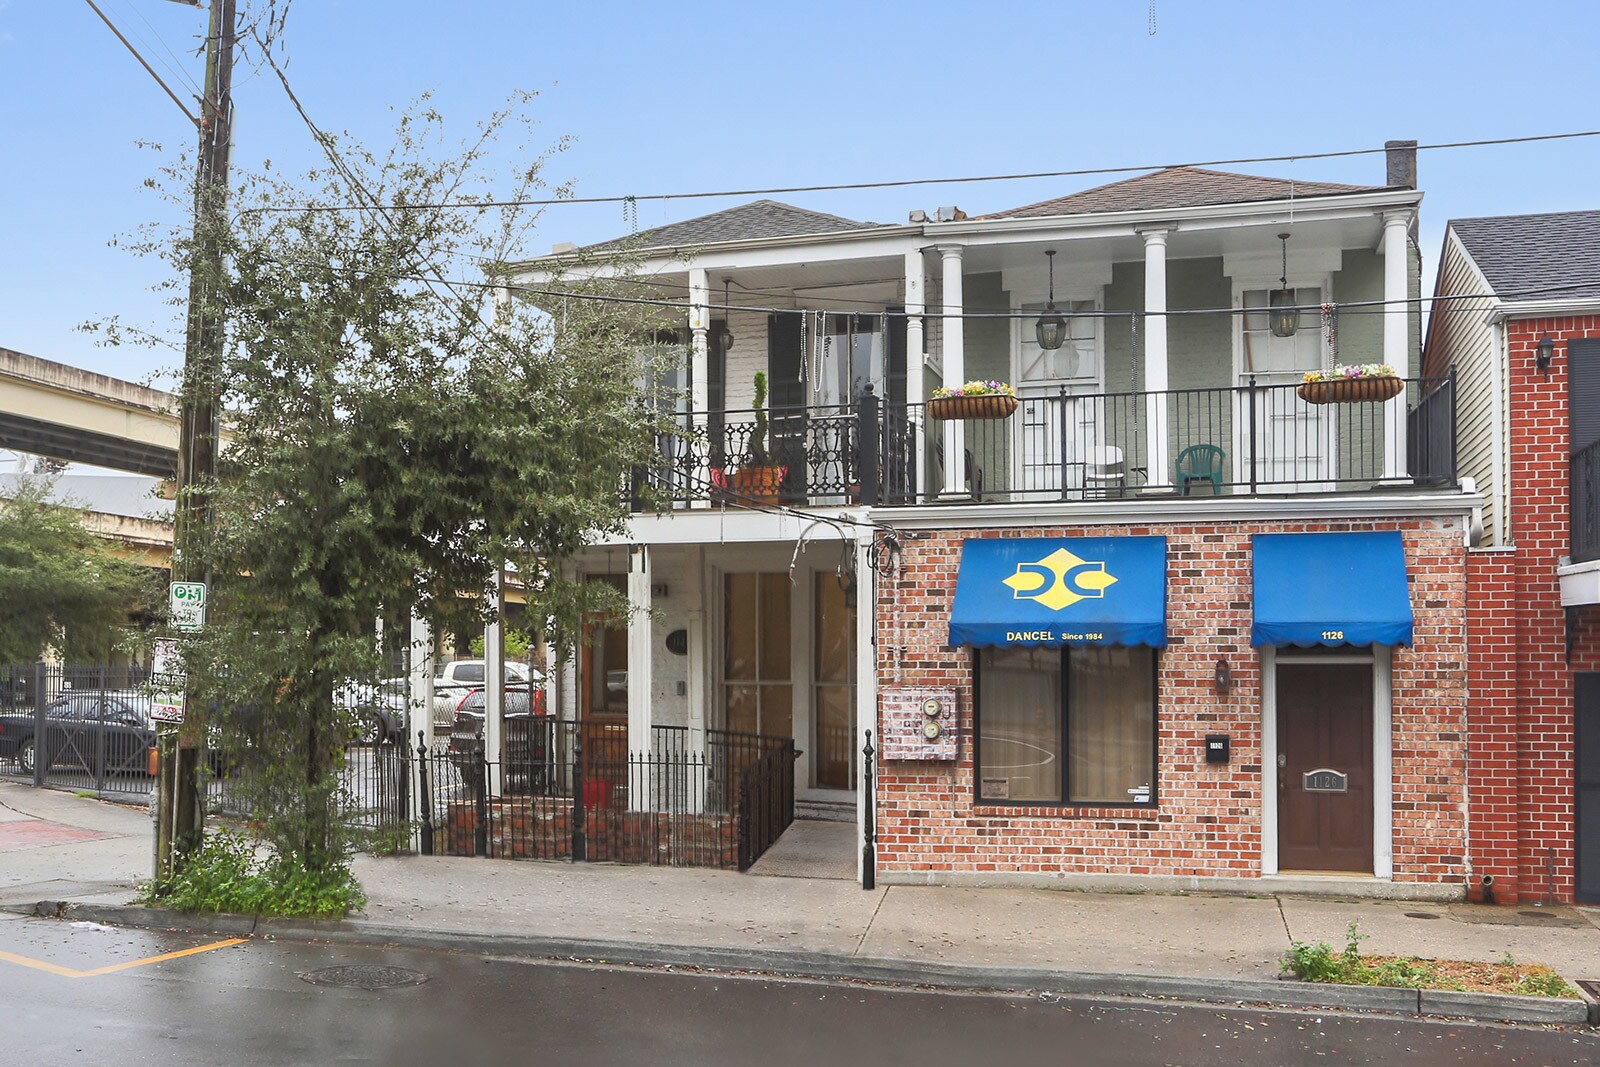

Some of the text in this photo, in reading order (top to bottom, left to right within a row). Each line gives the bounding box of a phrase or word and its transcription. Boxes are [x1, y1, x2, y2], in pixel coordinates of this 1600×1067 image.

[1007, 631, 1054, 641] DANCEL
[1062, 632, 1083, 640] Since
[1321, 631, 1344, 640] 1126
[1313, 776, 1337, 788] 1126
